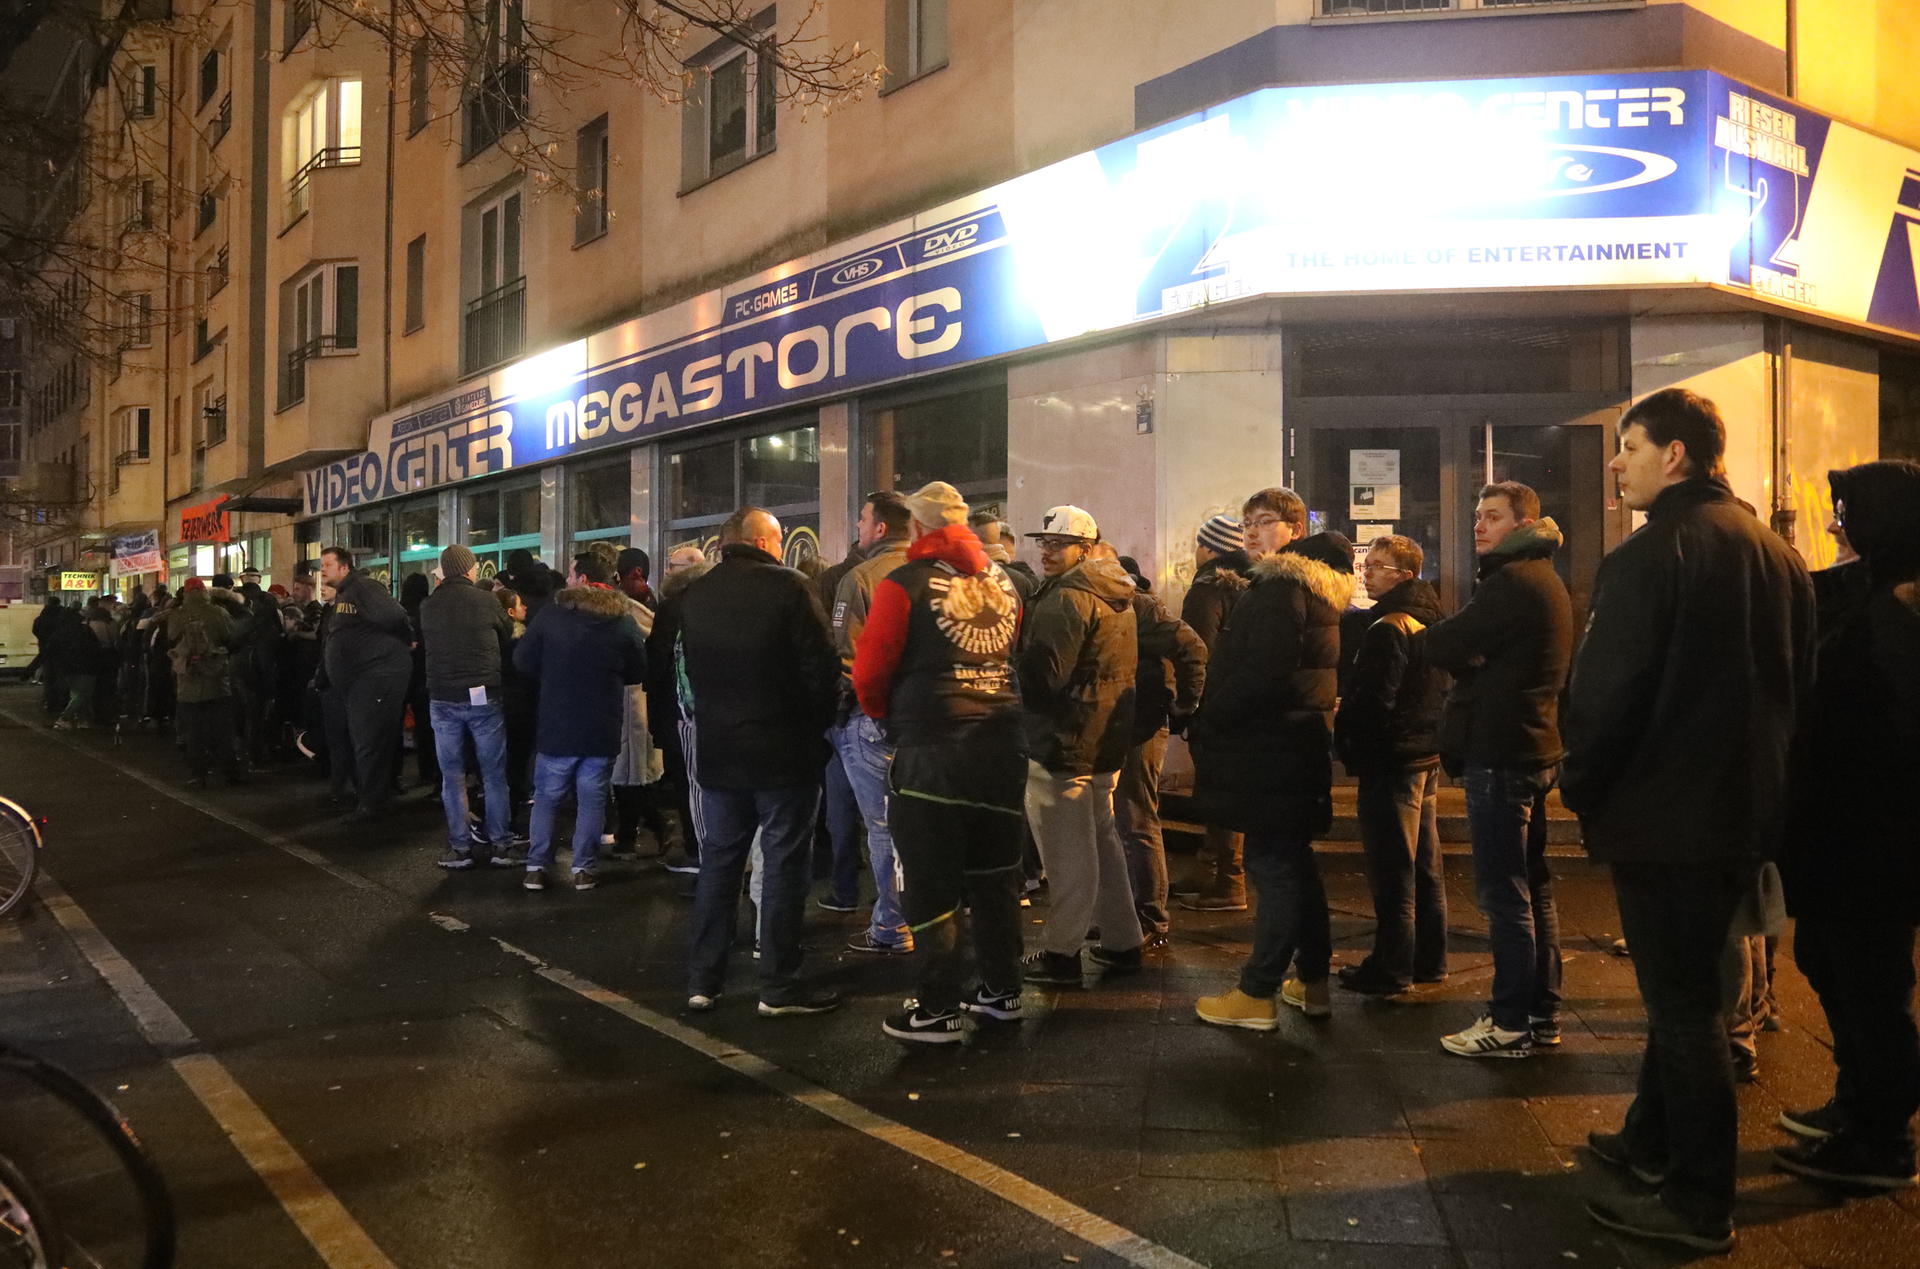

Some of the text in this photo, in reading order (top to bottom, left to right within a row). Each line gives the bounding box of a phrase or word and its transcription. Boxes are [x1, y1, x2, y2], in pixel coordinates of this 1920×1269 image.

[1728, 91, 1796, 145] RIESEN
[1714, 115, 1809, 177] AUSWAHL
[924, 223, 979, 251] DVD
[934, 241, 966, 255] VIDEO
[1286, 242, 1689, 268] THE HOME OF ENTERTAINMENT
[843, 262, 871, 281] VHS
[735, 282, 798, 320] PC-GAMES
[545, 286, 962, 450] MEGASTORE
[306, 410, 514, 514] VIDEO CENTER
